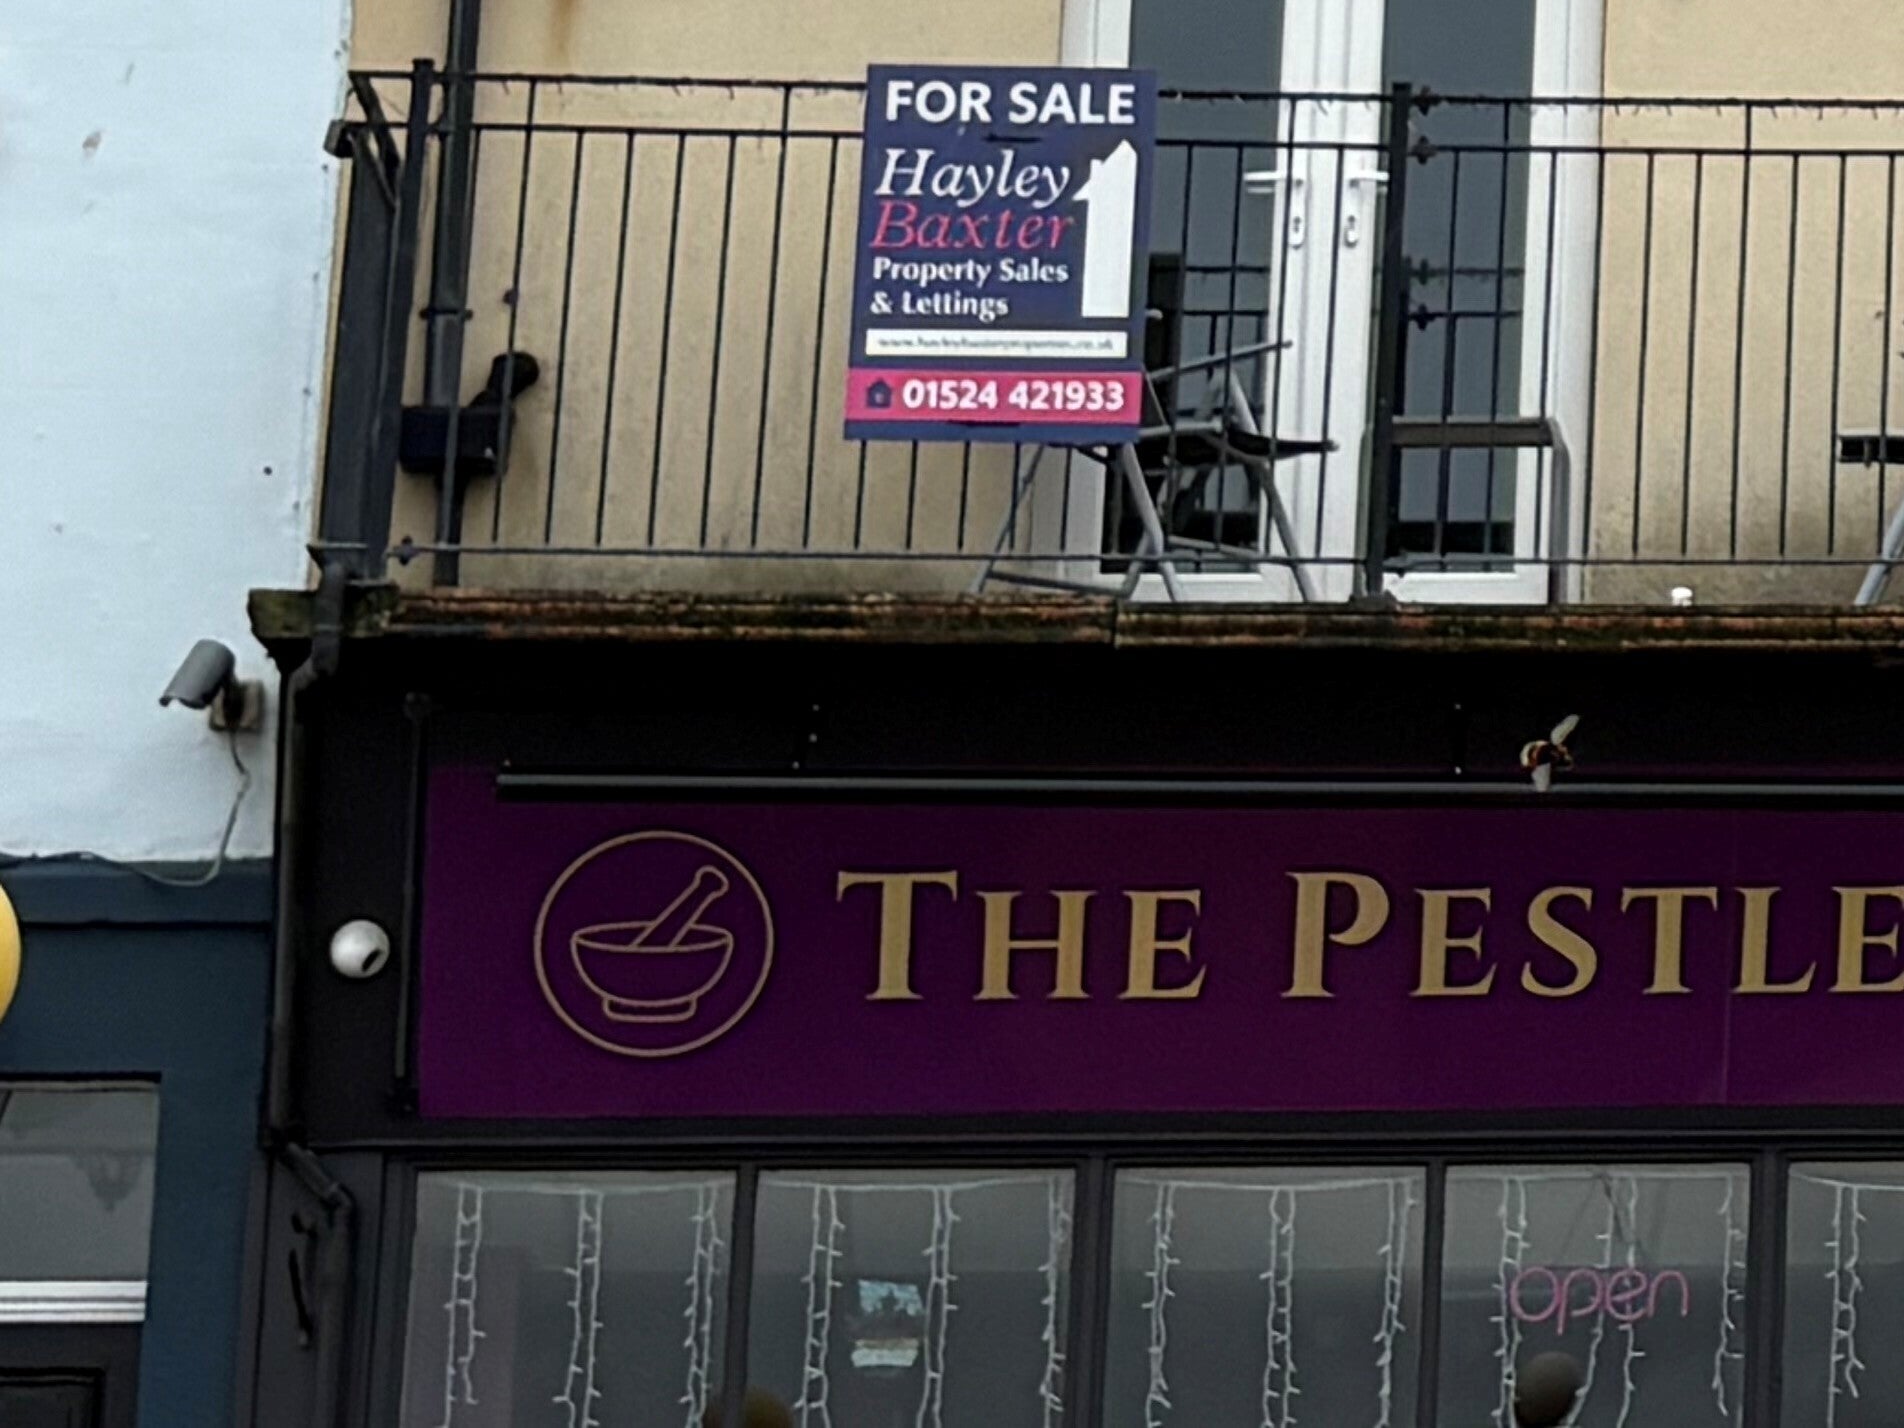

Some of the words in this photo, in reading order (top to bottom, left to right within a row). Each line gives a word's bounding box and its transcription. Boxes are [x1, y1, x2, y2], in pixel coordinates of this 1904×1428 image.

[886, 80, 992, 123] FOR
[1009, 82, 1135, 124] SALE
[874, 147, 1071, 208] Hayley
[871, 201, 1073, 250] Baxter
[873, 258, 992, 287] Property
[999, 257, 1068, 283] Sales
[870, 293, 892, 315] &
[902, 291, 1008, 322] Lettings
[902, 378, 998, 409] 01524
[1008, 380, 1124, 410] 421933
